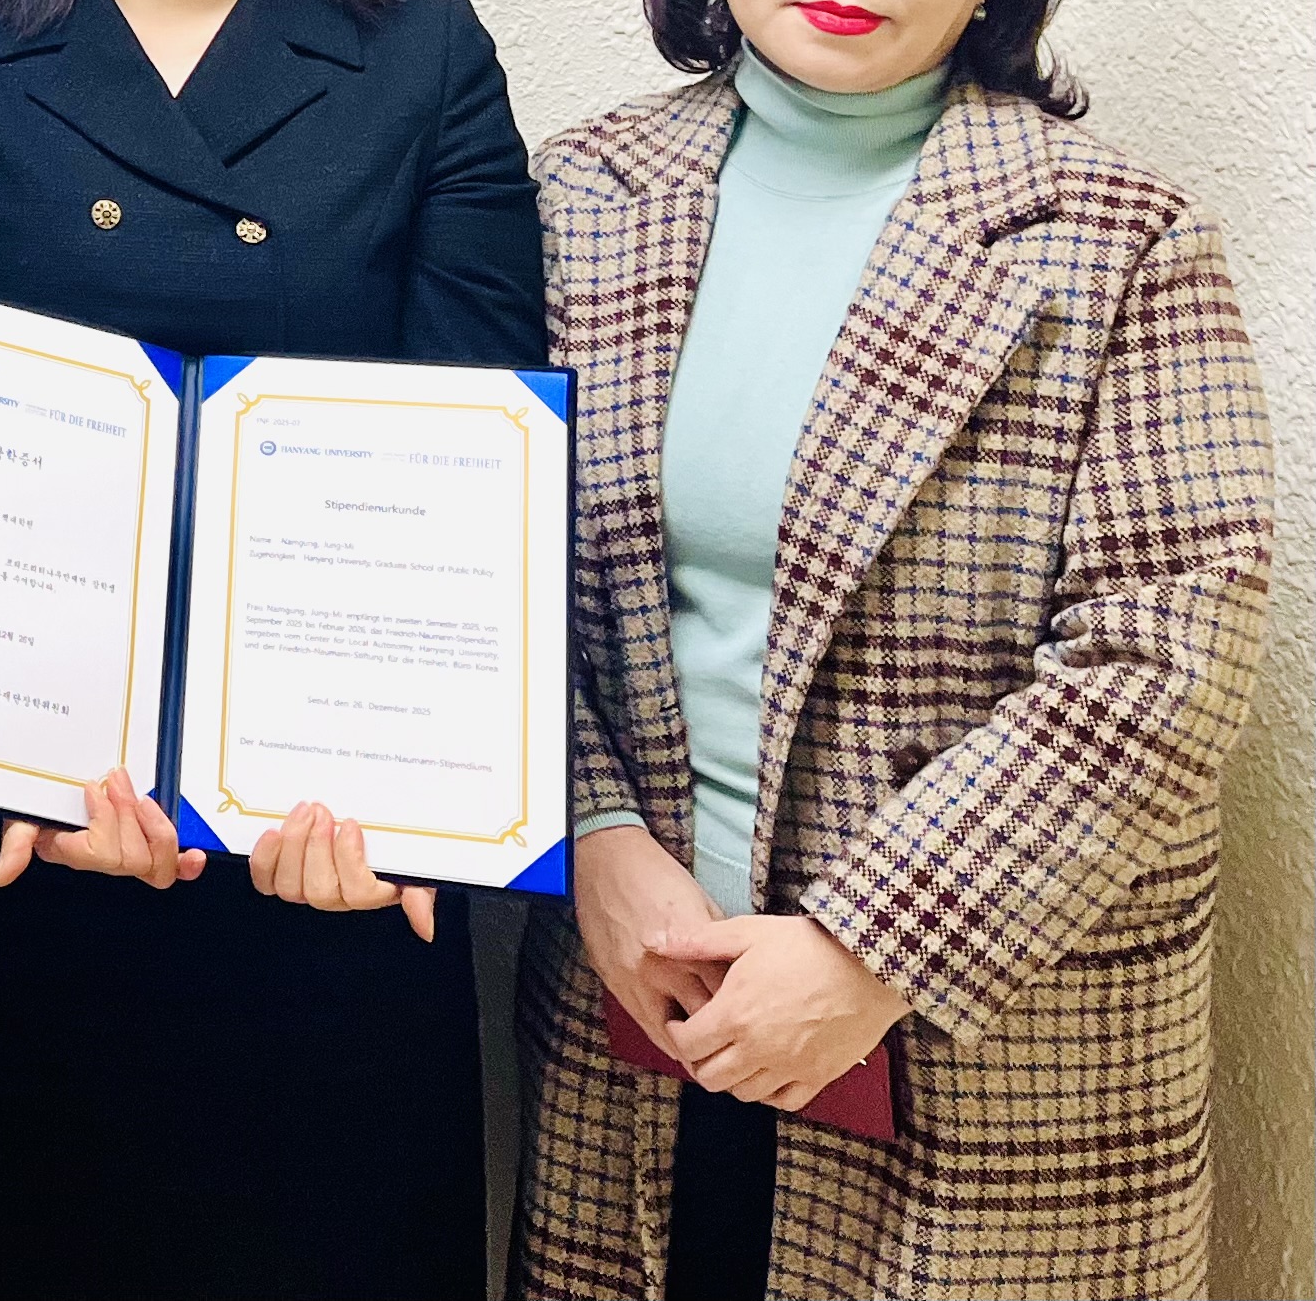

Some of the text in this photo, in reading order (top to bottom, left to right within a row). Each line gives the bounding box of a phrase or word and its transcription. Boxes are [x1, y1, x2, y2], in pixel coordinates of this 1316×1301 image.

[280, 445, 321, 455] HANYANG
[324, 448, 373, 458] UNIVERSITY
[324, 499, 426, 516] Stipendienurkunde
